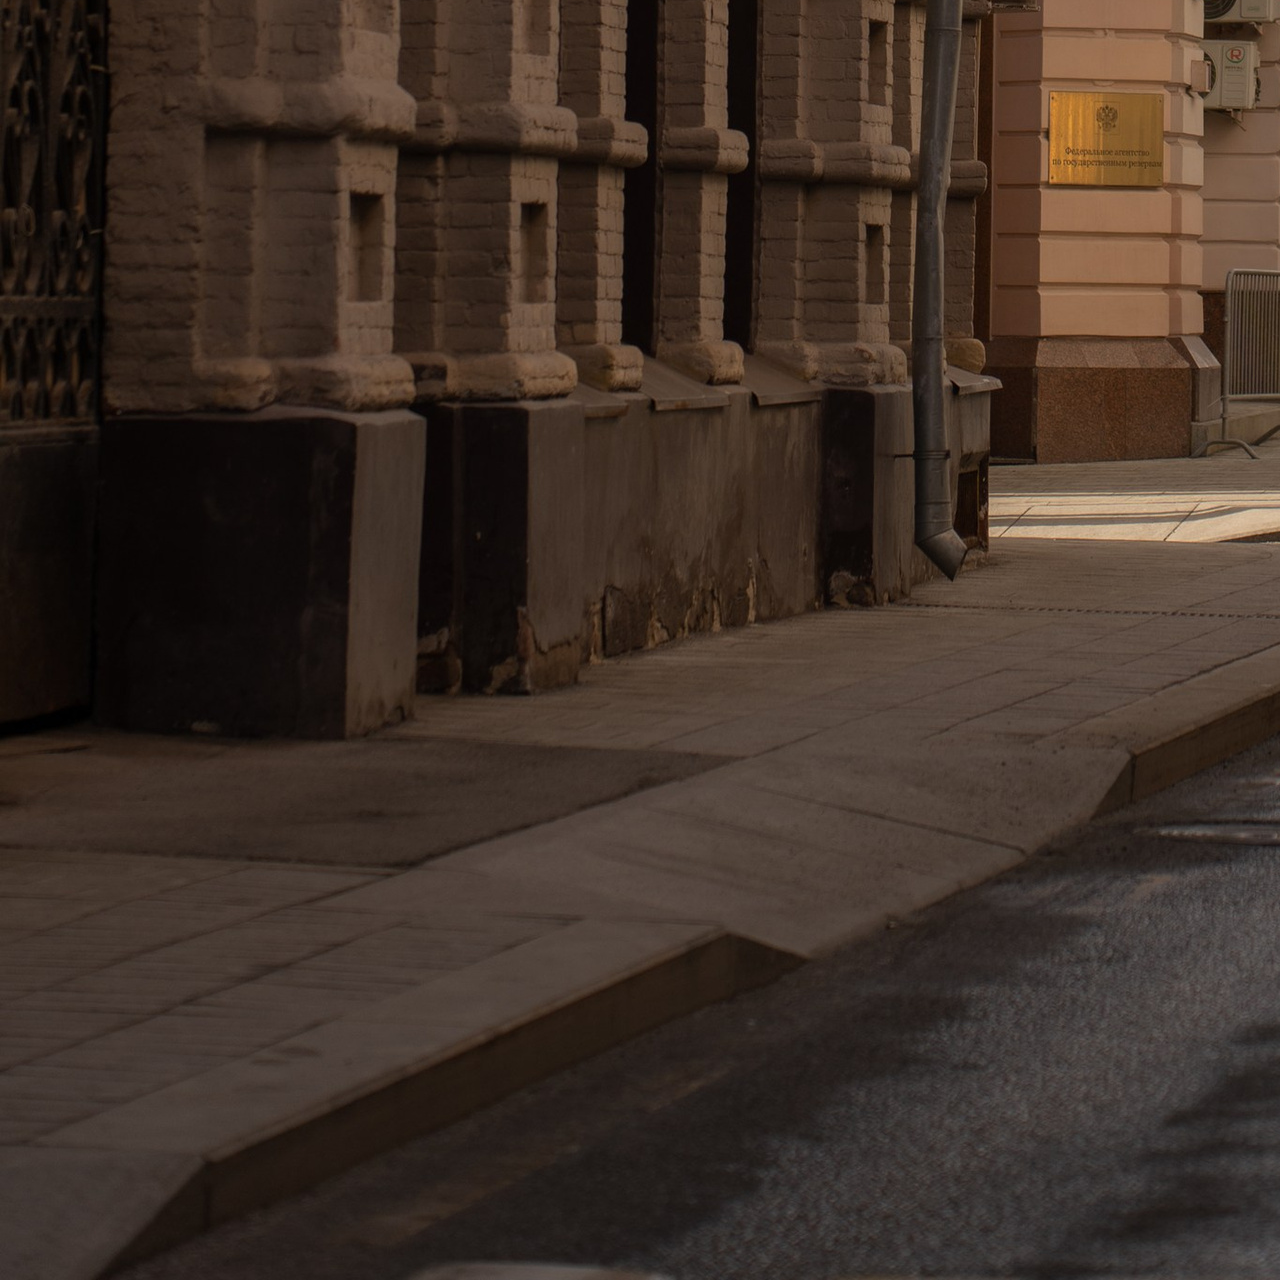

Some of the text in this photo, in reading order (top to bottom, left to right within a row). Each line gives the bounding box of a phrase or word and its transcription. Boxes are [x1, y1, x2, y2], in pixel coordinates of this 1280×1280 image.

[1065, 146, 1113, 157] Федеральное
[1063, 159, 1127, 168] государственным
[1128, 161, 1162, 170] резервам
